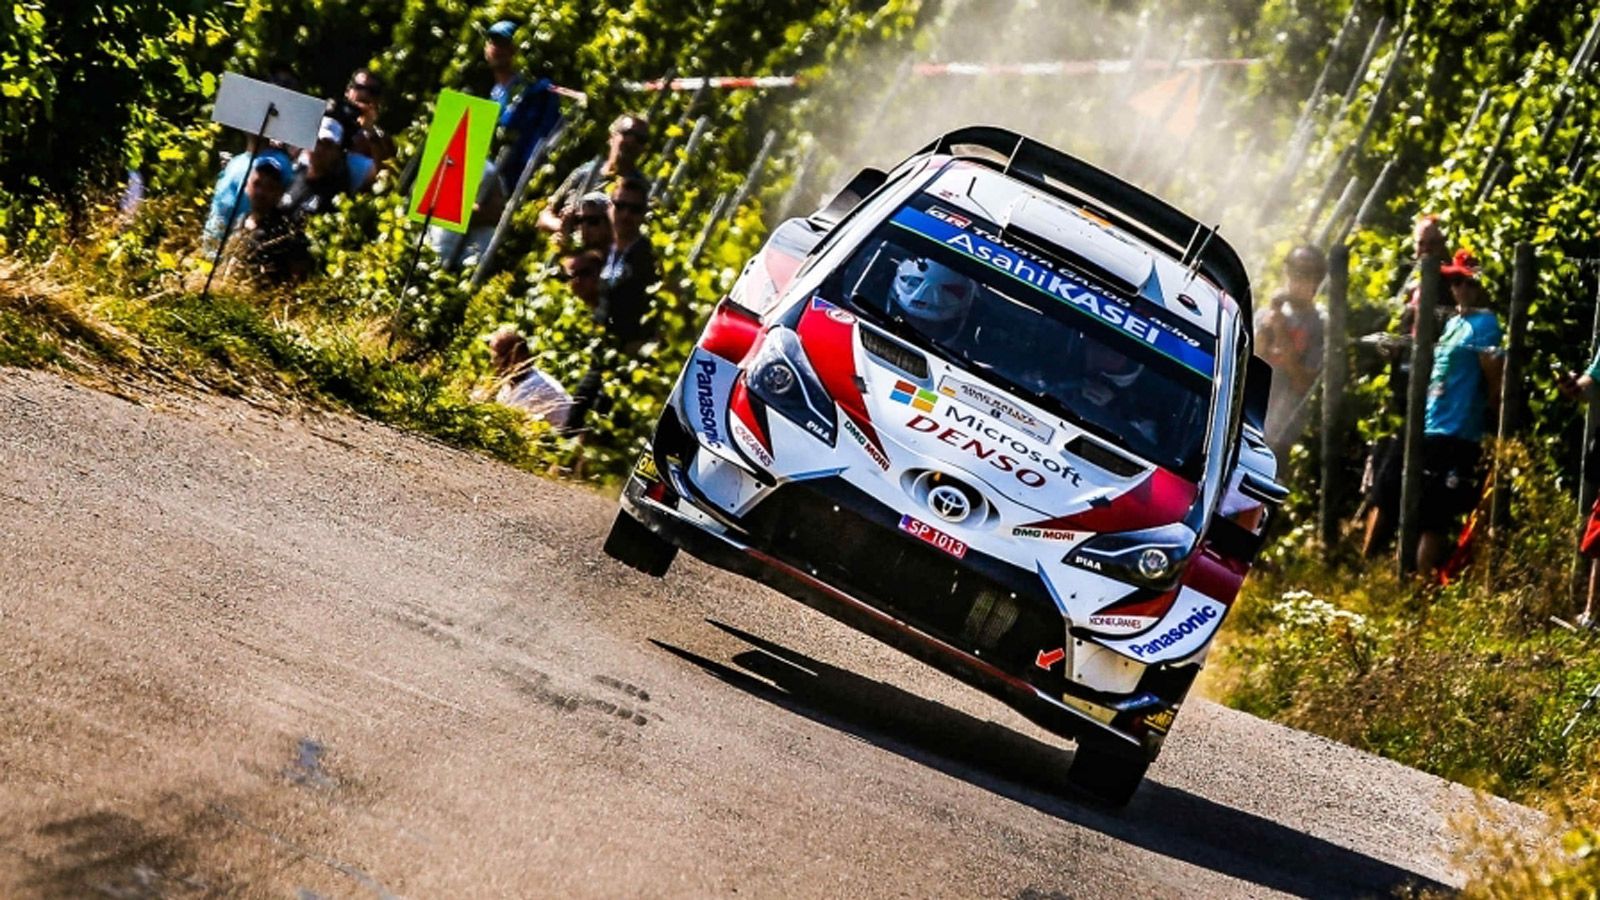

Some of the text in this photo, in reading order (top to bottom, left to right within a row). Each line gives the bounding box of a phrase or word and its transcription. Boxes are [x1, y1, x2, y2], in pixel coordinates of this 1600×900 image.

[973, 226, 1054, 269] TOYOTA
[1058, 267, 1131, 308] GAZOO
[696, 359, 725, 449] Panasonic
[806, 420, 831, 441] PIAA
[843, 420, 891, 472] DMG MORI
[906, 414, 1047, 488] DENSO
[945, 405, 1083, 488] Microsoft
[908, 519, 964, 556] SP 1013
[1012, 527, 1075, 541] DMG MORI
[1075, 555, 1102, 571] PIAA
[1129, 604, 1218, 658] Panasonic
